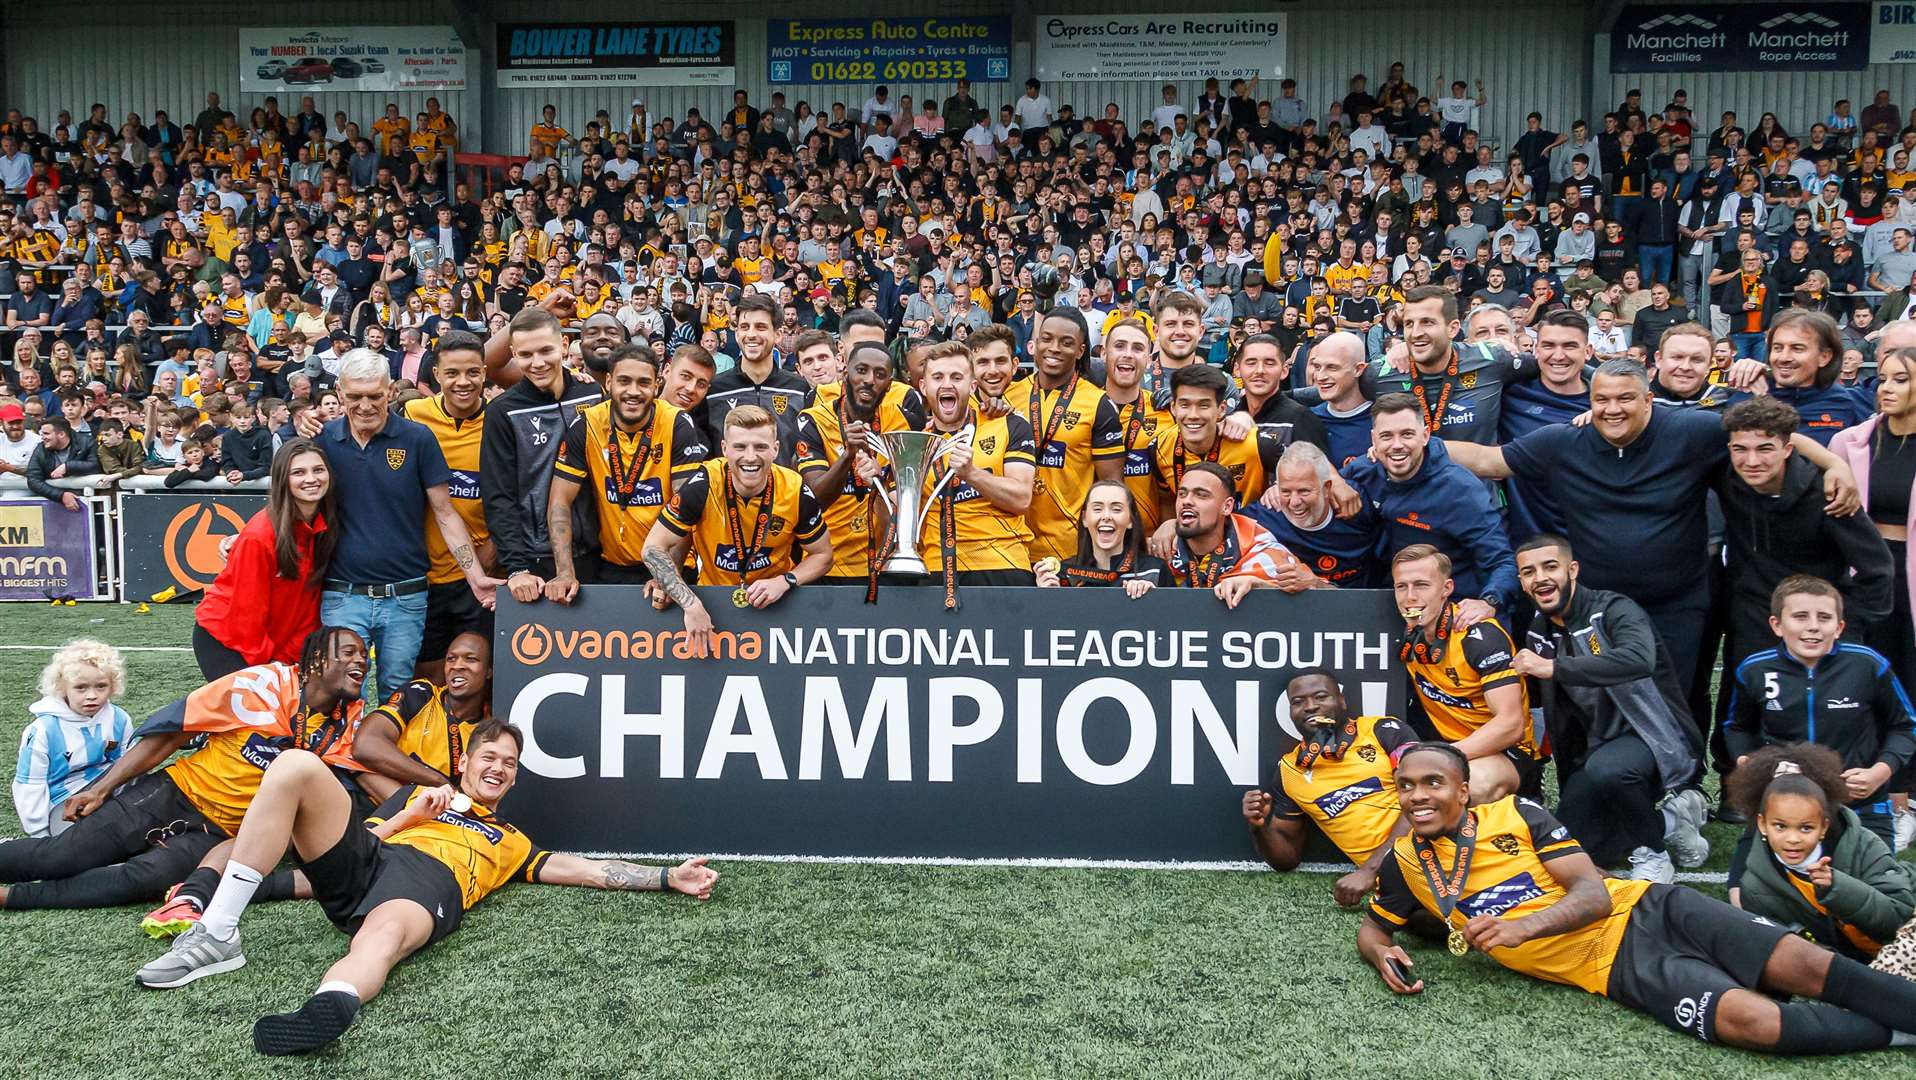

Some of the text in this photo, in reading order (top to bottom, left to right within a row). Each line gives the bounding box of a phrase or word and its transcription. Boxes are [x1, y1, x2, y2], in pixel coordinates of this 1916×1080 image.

[788, 20, 989, 43] Express Auto Centre
[1047, 19, 1279, 40] Express Cars Are Recruiting
[510, 25, 721, 56] BOWER LANE TYRES
[1627, 32, 1727, 49] Manchett
[1748, 31, 1849, 48] Manchett
[250, 46, 268, 57] Your
[271, 46, 306, 57] NUMBER
[317, 45, 337, 56] local
[339, 44, 366, 55] Suzuki
[367, 45, 390, 55] team
[771, 45, 1008, 58] MOT Servicing Repairs Tyres Brakes
[1651, 52, 1702, 62] Facilities
[1760, 51, 1838, 62] Rope Access
[811, 60, 967, 81] 01622 690333
[1100, 70, 1150, 78] information
[1152, 70, 1179, 79] please
[1200, 69, 1218, 77] TAXI
[1442, 412, 1474, 426] chett
[532, 432, 548, 445] 26
[1042, 455, 1064, 467] hett
[448, 485, 480, 497] chett
[607, 491, 662, 505] Mchett
[4, 579, 68, 587] BIGGEST HITS
[768, 627, 1009, 666] NATIONAL
[1024, 629, 1209, 668] LEAGUE
[1222, 632, 1389, 671] SOUTH
[1764, 672, 1780, 699] 5
